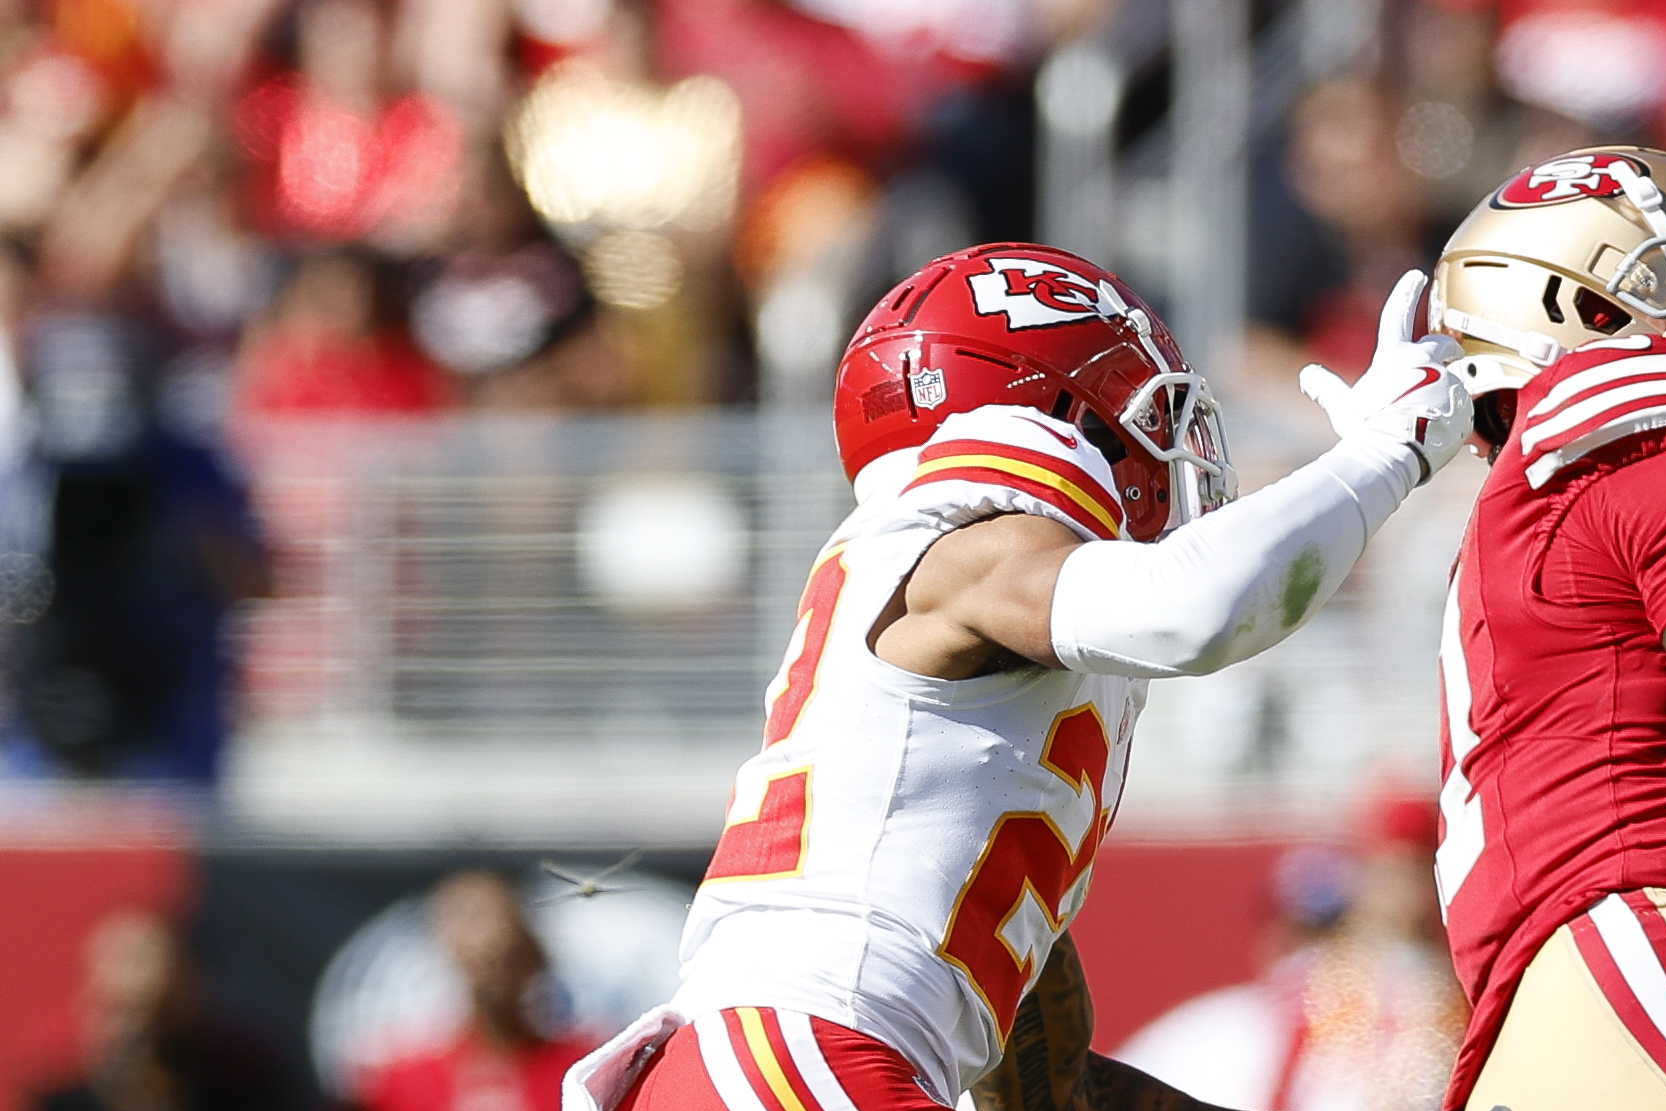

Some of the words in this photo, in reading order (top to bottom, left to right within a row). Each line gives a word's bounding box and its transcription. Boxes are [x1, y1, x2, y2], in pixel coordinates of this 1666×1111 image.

[998, 267, 1100, 314] KC
[917, 385, 941, 402] NFL
[935, 699, 1113, 1054] 2
